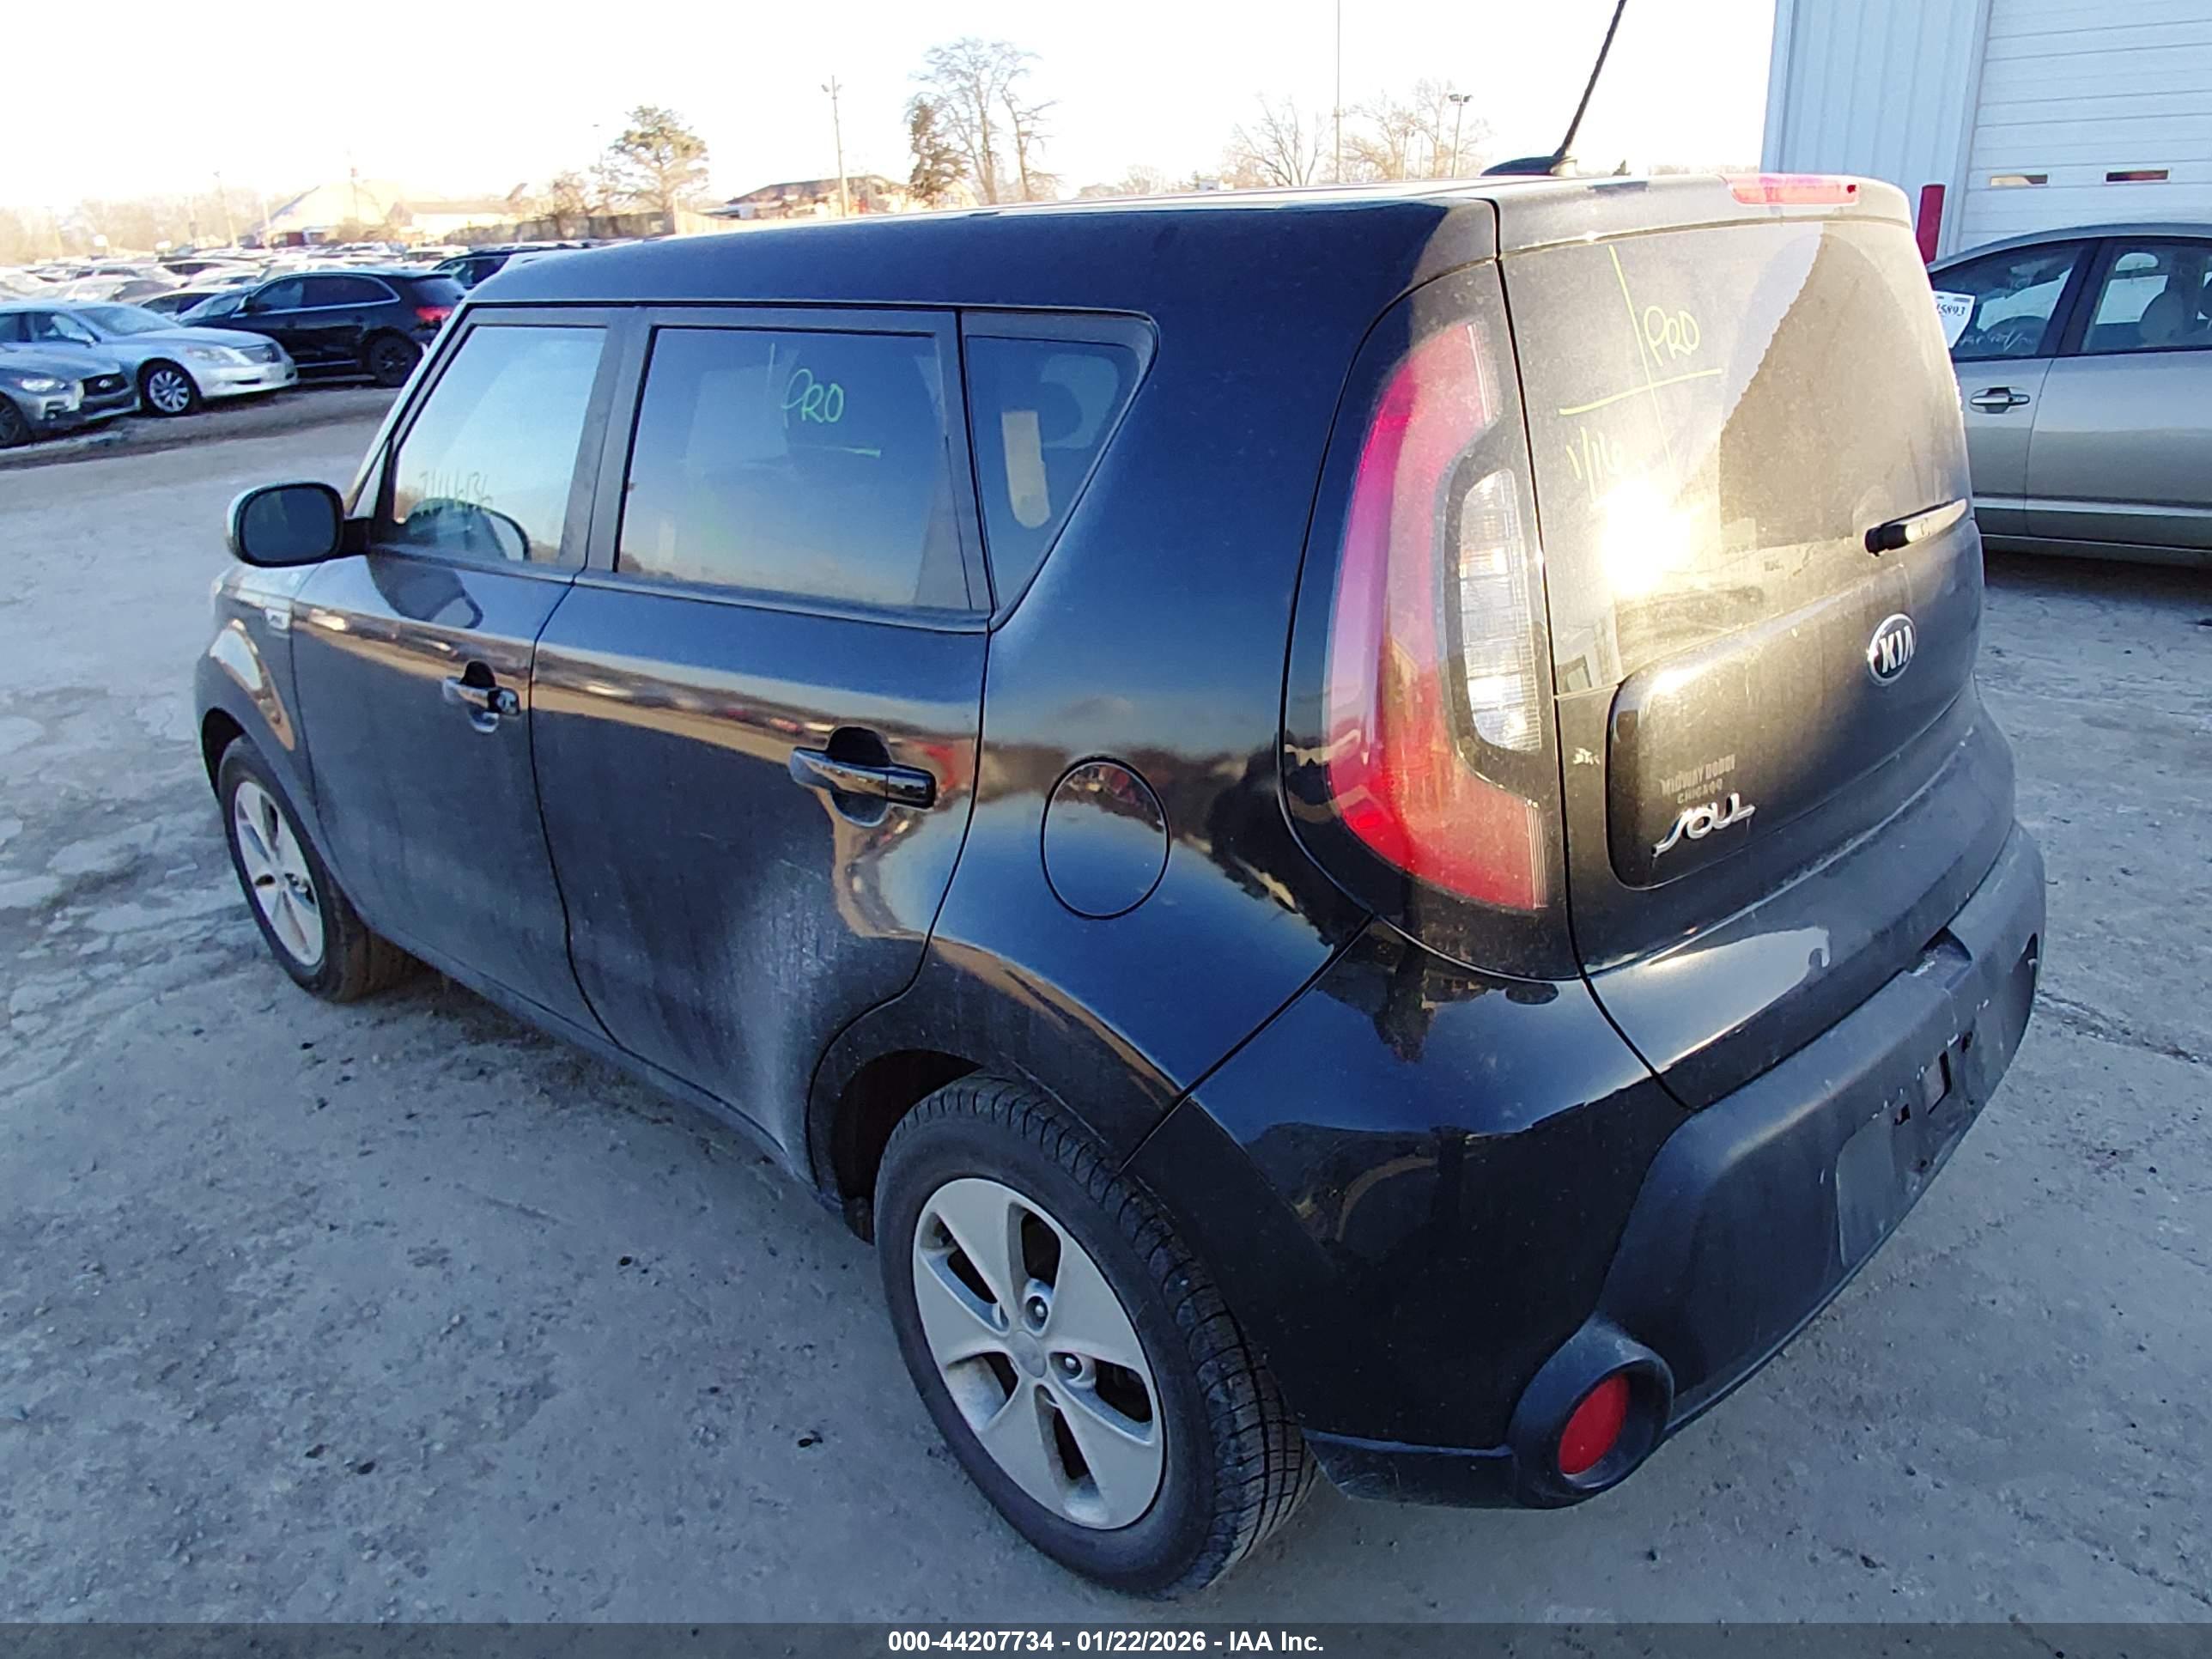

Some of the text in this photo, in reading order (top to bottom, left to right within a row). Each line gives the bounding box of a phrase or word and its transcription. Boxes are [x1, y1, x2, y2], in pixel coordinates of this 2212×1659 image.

[781, 368, 844, 428] PRO
[1879, 626, 1915, 673] KIA
[1651, 793, 1755, 858] SOUL
